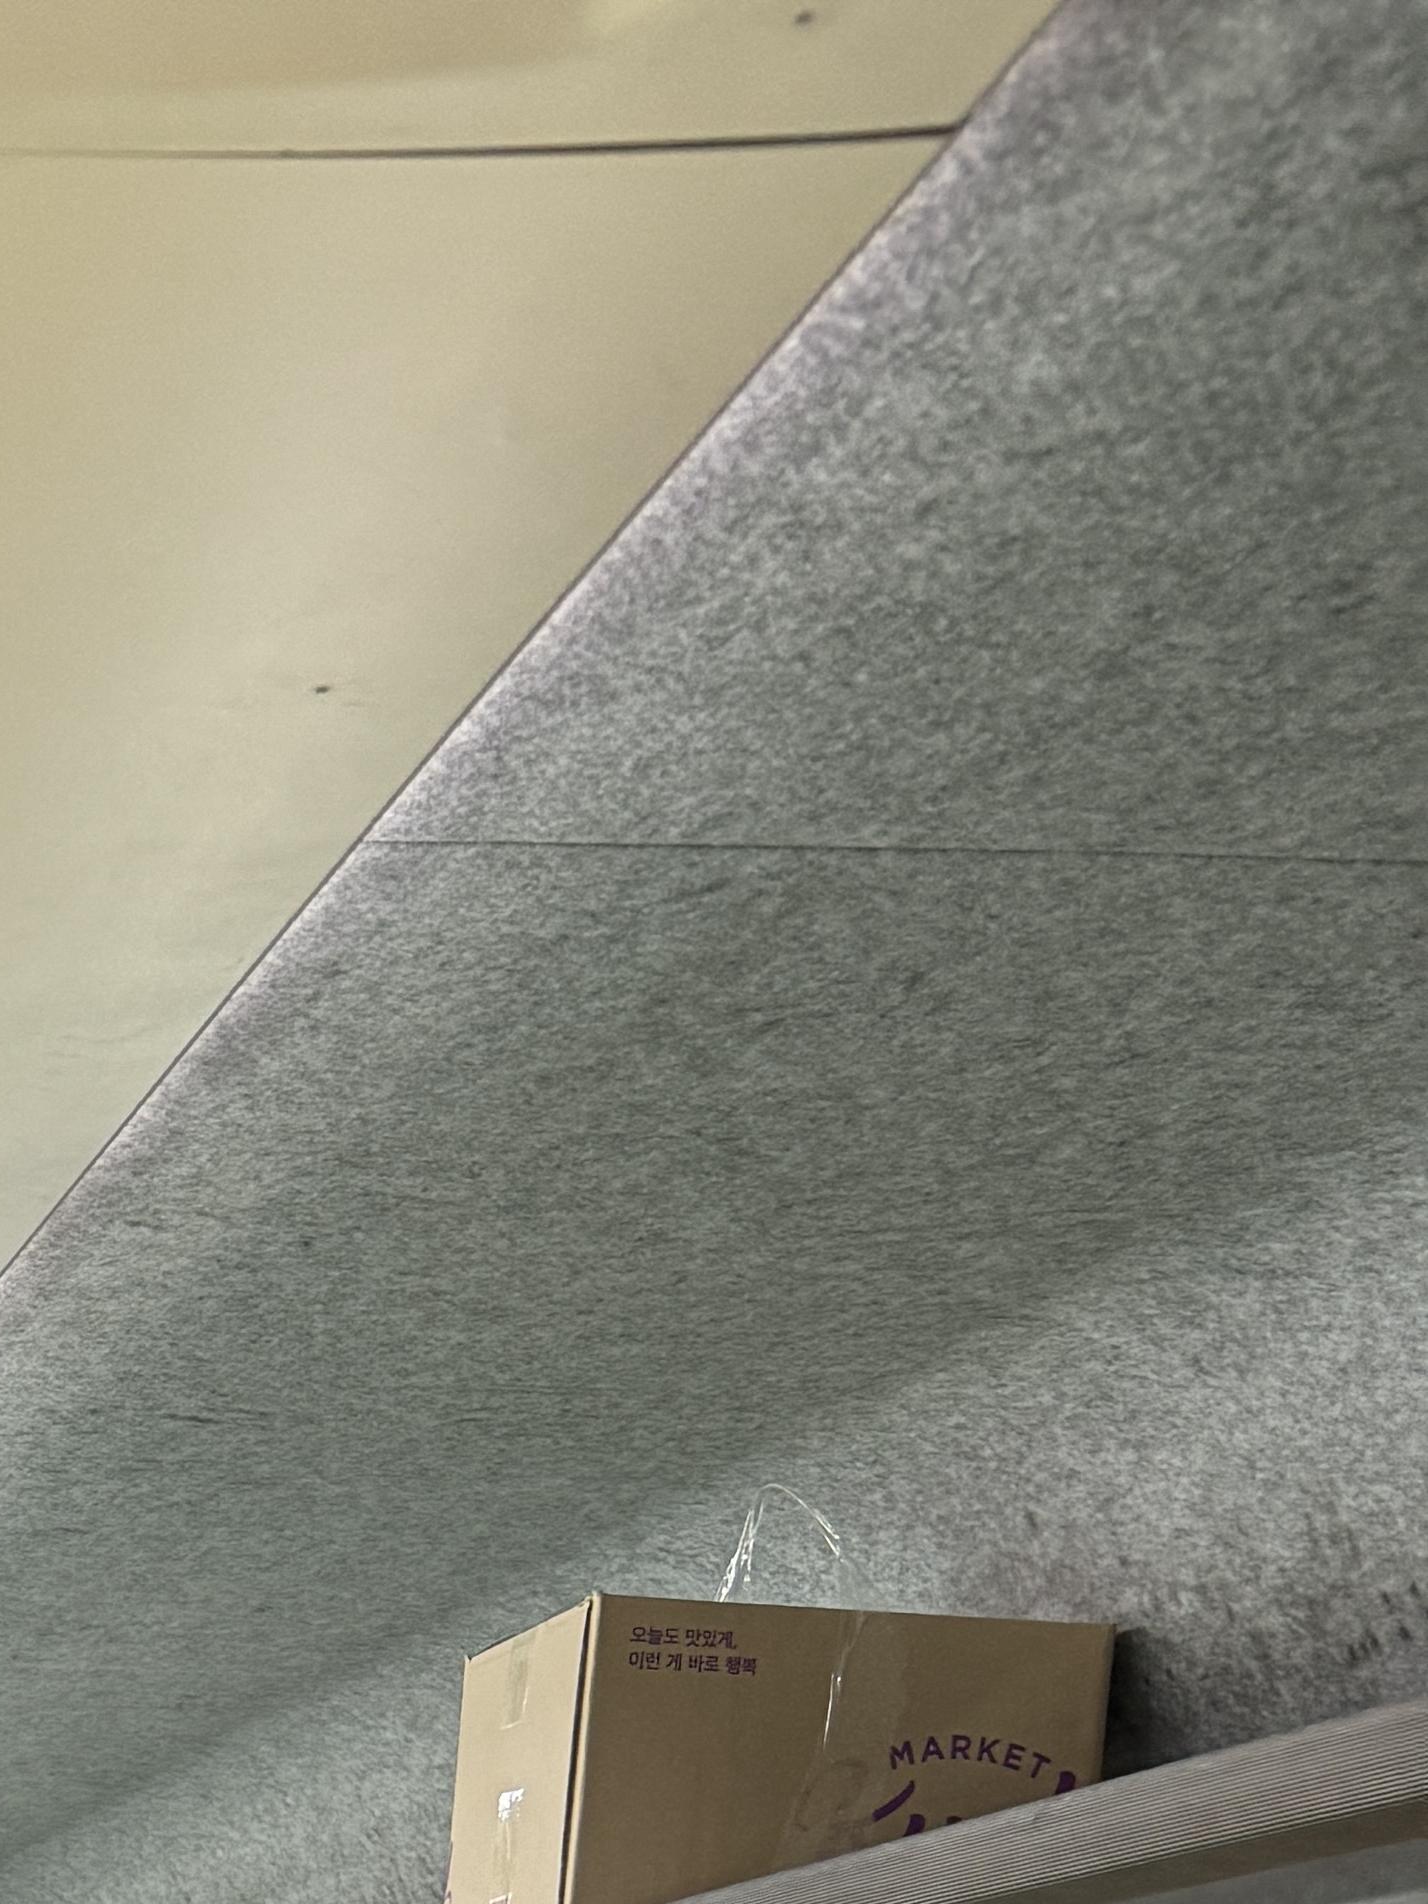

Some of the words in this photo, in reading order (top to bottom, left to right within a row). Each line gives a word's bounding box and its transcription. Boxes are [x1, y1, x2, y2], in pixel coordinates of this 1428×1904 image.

[629, 1626, 680, 1646] 오늘도
[684, 1628, 737, 1651] 맛있게,
[628, 1650, 663, 1671] 이런
[666, 1652, 683, 1672] 게
[688, 1653, 720, 1674] 바로
[888, 1734, 1052, 1780] MARKET
